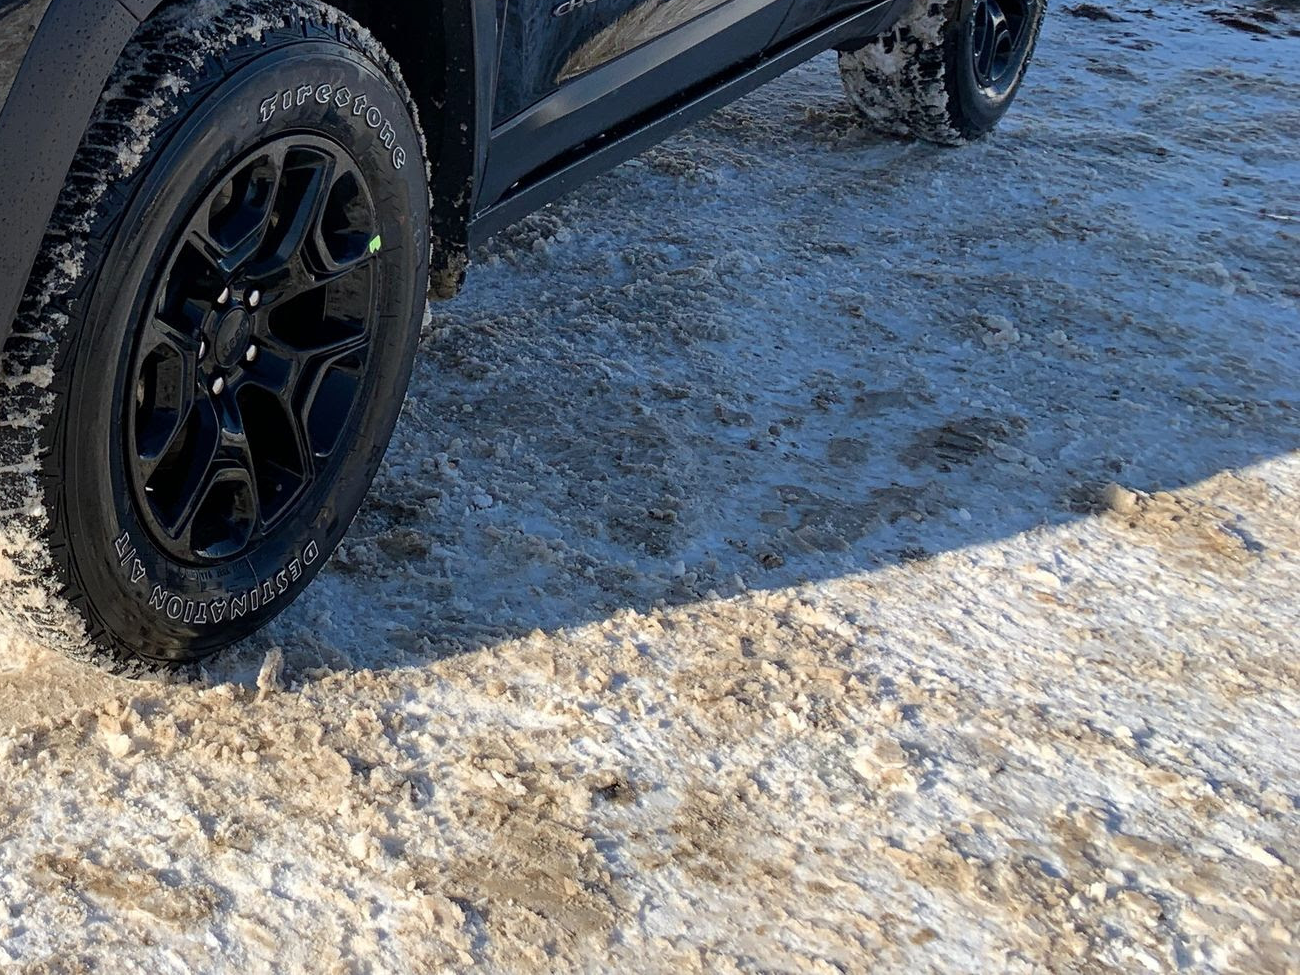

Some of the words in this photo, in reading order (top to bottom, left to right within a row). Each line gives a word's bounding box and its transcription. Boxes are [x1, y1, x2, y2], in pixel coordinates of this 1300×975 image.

[260, 84, 406, 169] Firestone
[114, 531, 146, 583] A/T
[149, 540, 319, 624] DESTINATION
